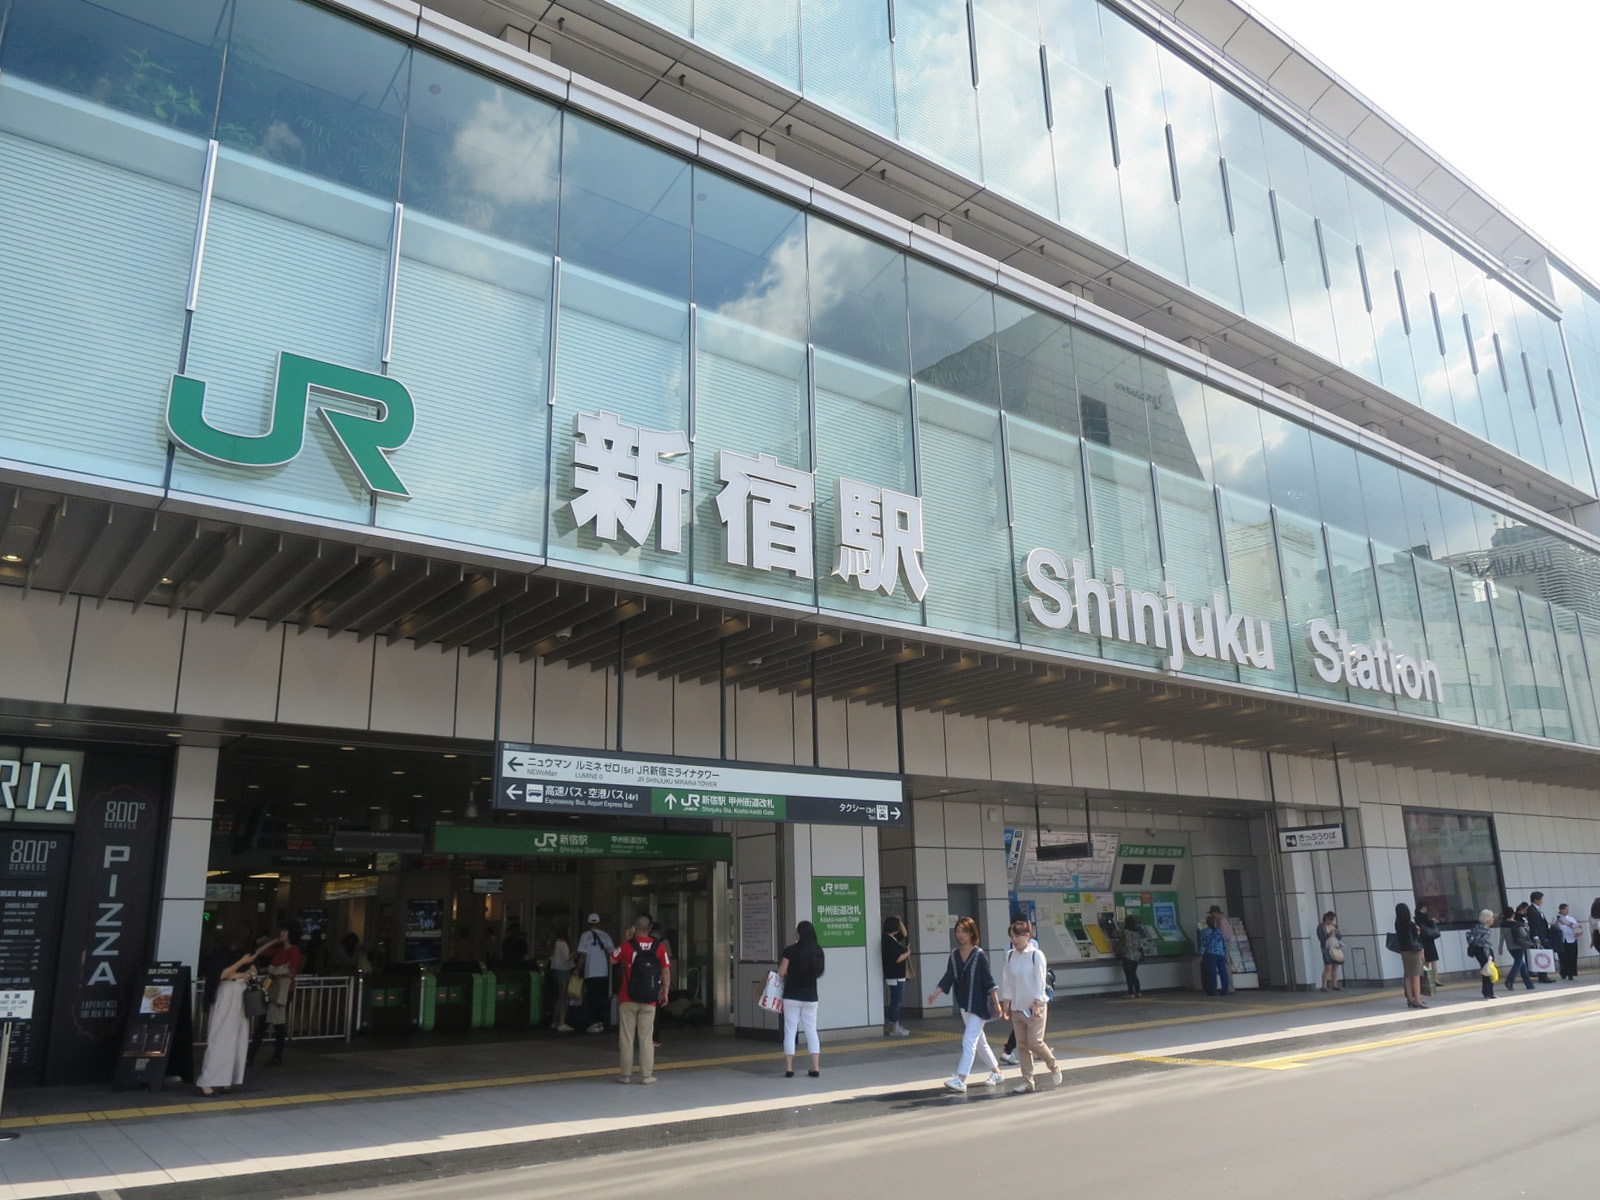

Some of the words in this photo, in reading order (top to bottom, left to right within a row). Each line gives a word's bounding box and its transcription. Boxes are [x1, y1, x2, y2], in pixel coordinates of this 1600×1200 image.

[165, 350, 416, 501] JR
[569, 410, 928, 602] 新宿駅
[1021, 547, 1275, 671] Shinjuku
[1304, 618, 1442, 702] Station
[527, 758, 572, 769] ニュウマン
[637, 766, 720, 779] JR新宿ミライナタワー
[575, 772, 598, 780] LUMINE
[646, 777, 674, 785] SHINJUKU
[698, 780, 718, 788] TOWER
[587, 800, 604, 808] Airport
[680, 794, 700, 807] JR
[702, 794, 726, 806] 新宿駅
[728, 796, 775, 808] 甲州街道改札
[702, 806, 722, 814] Shinjuku
[840, 803, 865, 812] タクシー
[534, 833, 558, 848] JR
[560, 834, 588, 846] 新宿駅
[1298, 832, 1336, 842] きっぷうりば
[584, 846, 604, 854] Station
[8, 863, 46, 872] DEGREES
[821, 883, 833, 893] JR
[87, 846, 130, 986] PIZZA
[817, 905, 862, 916] 甲州街道改札
